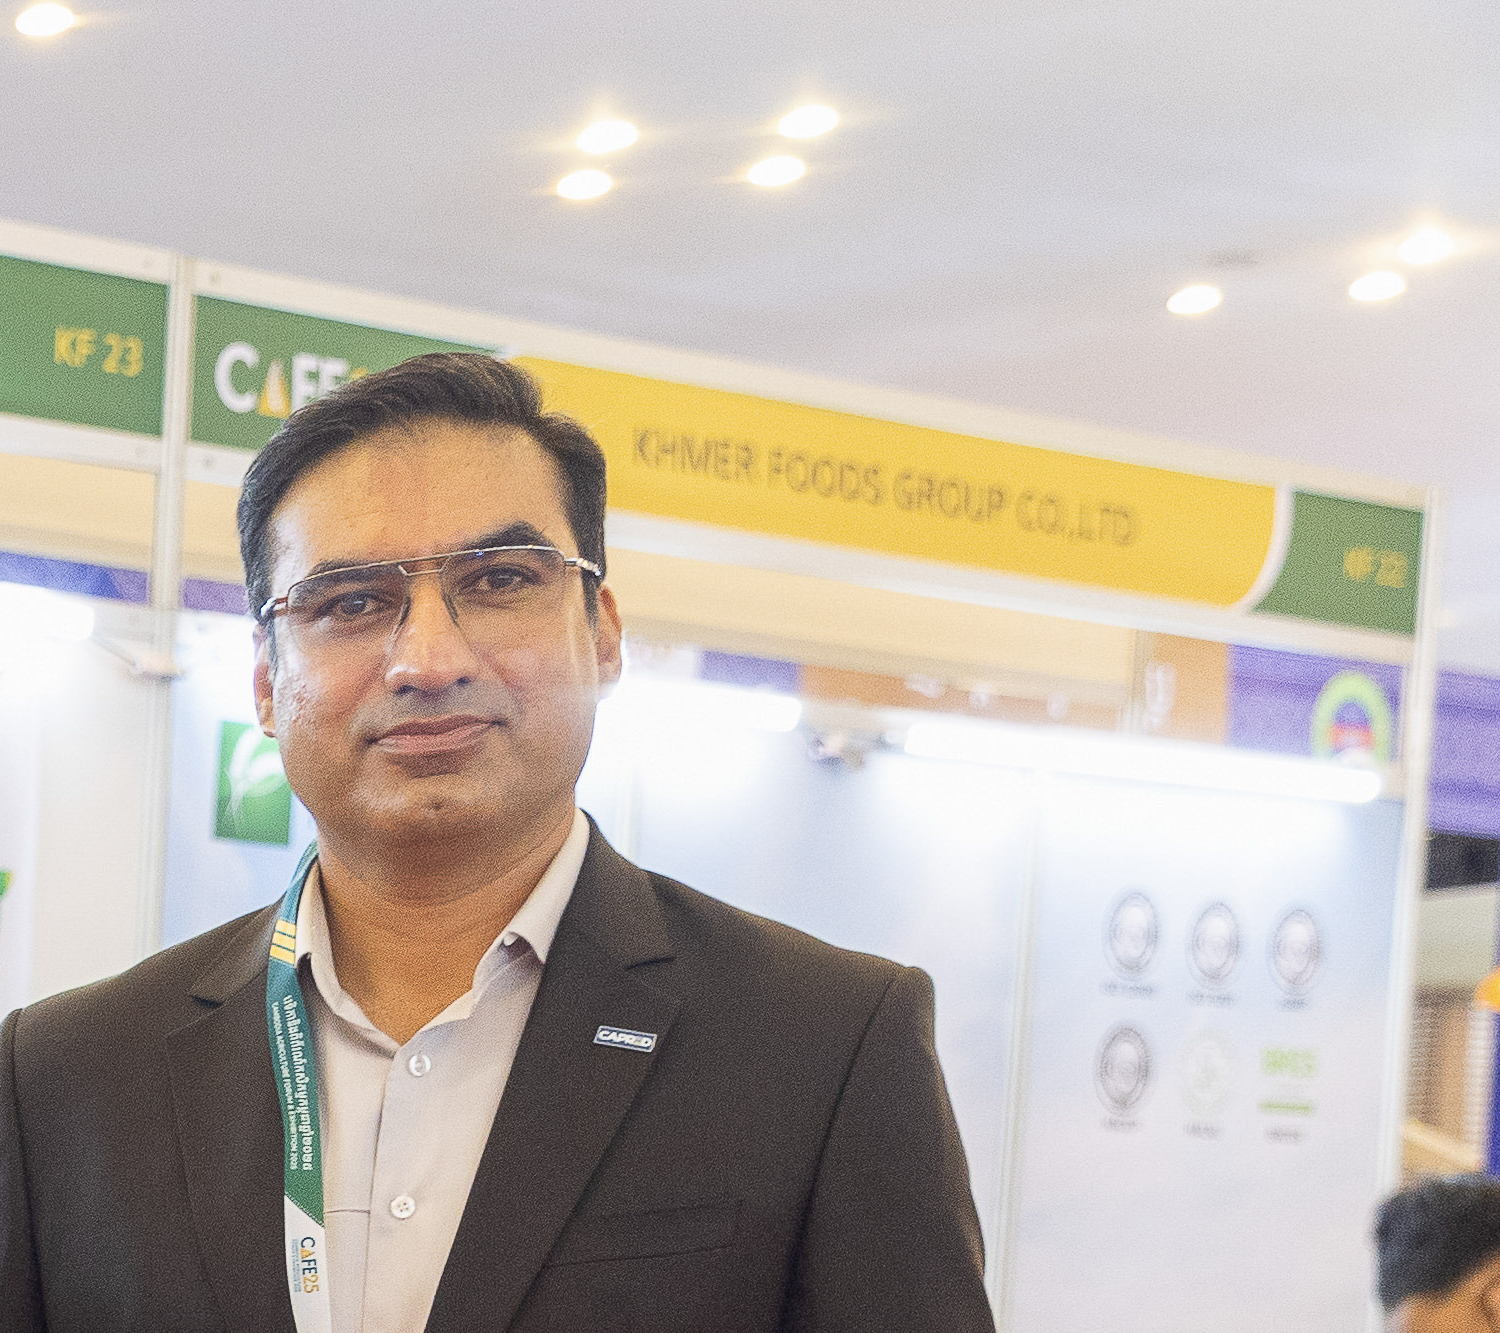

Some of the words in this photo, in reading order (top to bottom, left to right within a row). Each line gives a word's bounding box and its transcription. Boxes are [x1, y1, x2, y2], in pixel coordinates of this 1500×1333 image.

[54, 326, 97, 368] KF
[102, 332, 145, 377] 23
[214, 340, 367, 418] CAFE
[632, 426, 753, 482] KHMER
[767, 451, 883, 507] FOODS
[894, 471, 1008, 524] GROUP
[299, 1235, 320, 1294] CAFE25
